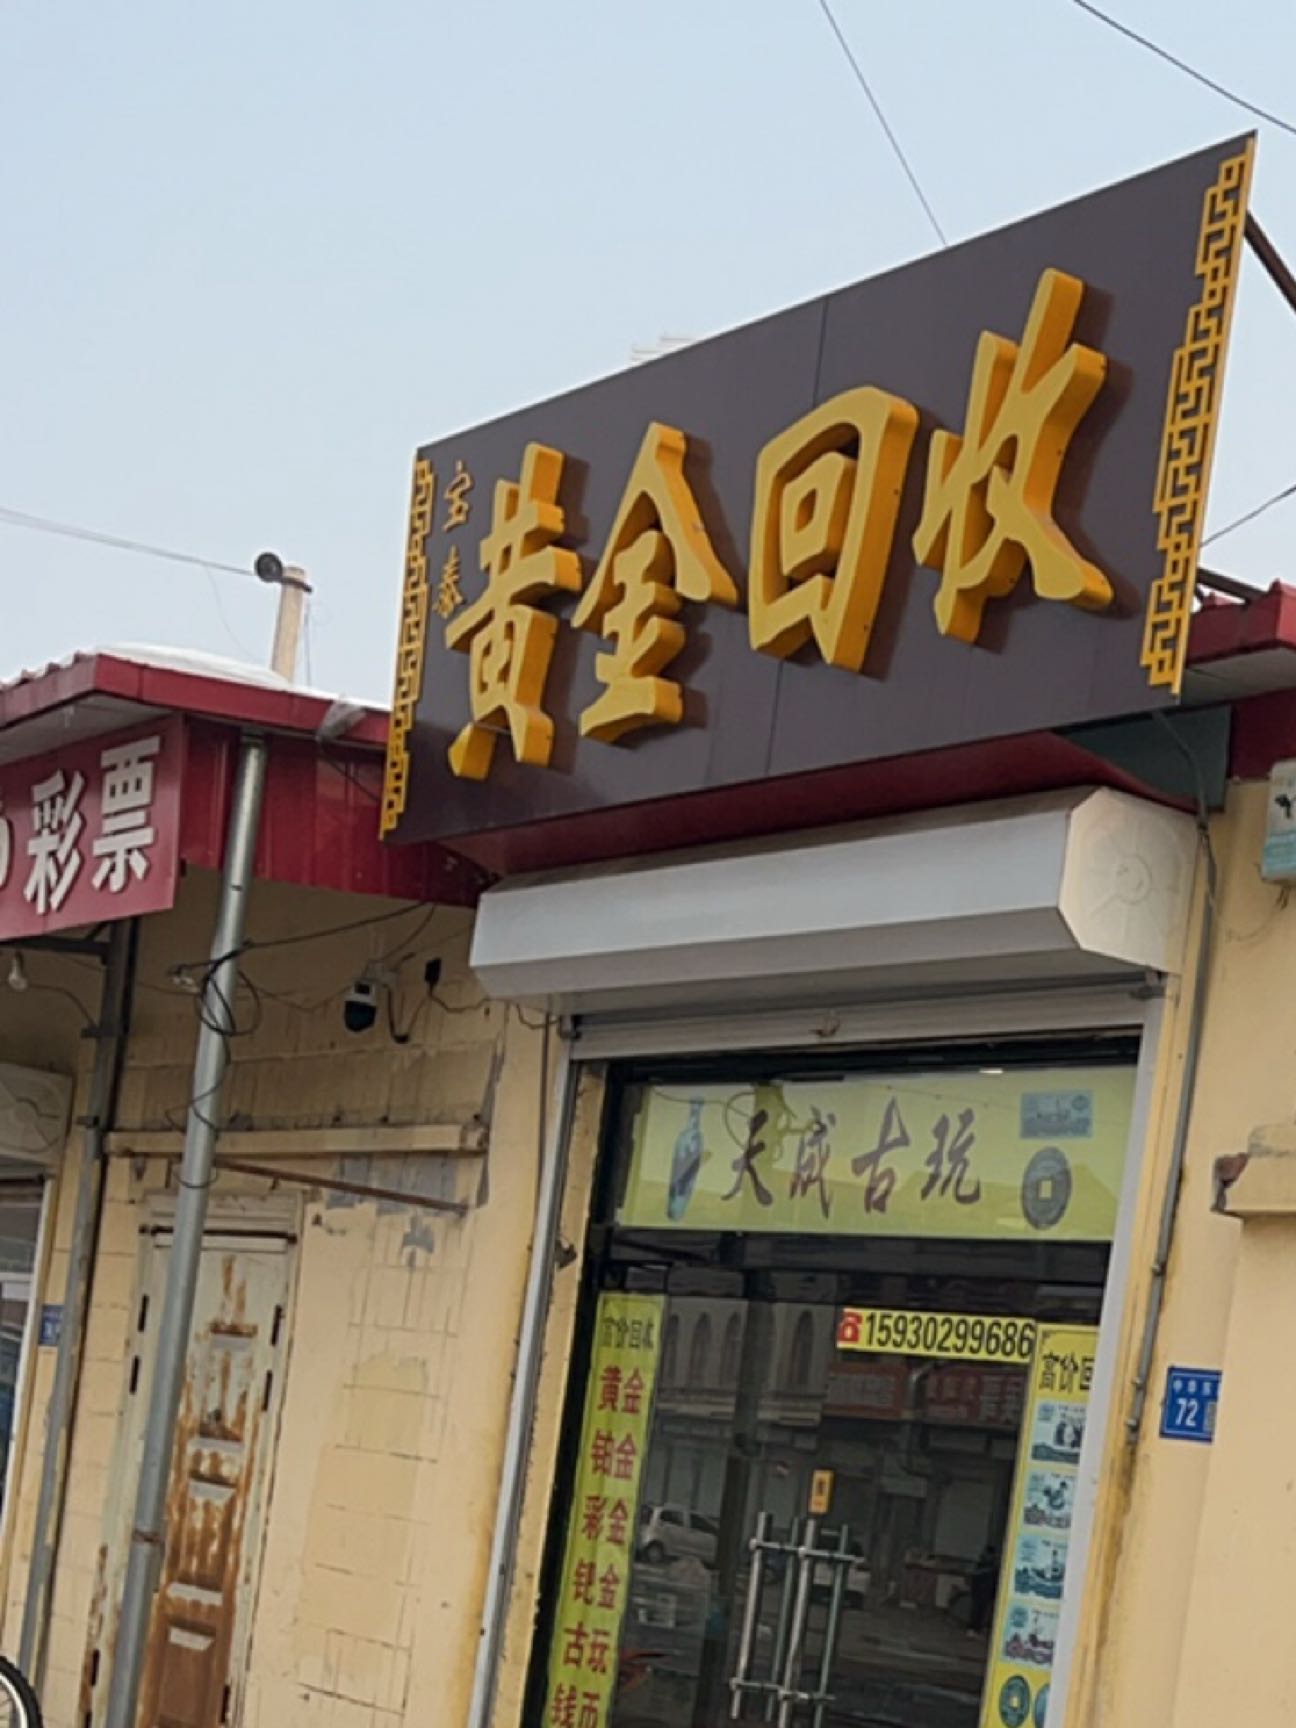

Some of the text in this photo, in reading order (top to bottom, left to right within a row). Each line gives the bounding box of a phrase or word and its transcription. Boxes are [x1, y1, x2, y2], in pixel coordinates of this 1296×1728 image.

[444, 266, 1115, 782] 黄金回收
[865, 1311, 1037, 1358] 15930299686
[597, 1366, 644, 1415] 黄金
[1174, 1397, 1198, 1427] 72
[582, 1494, 629, 1546] 彩金
[563, 1621, 611, 1673] 古玩
